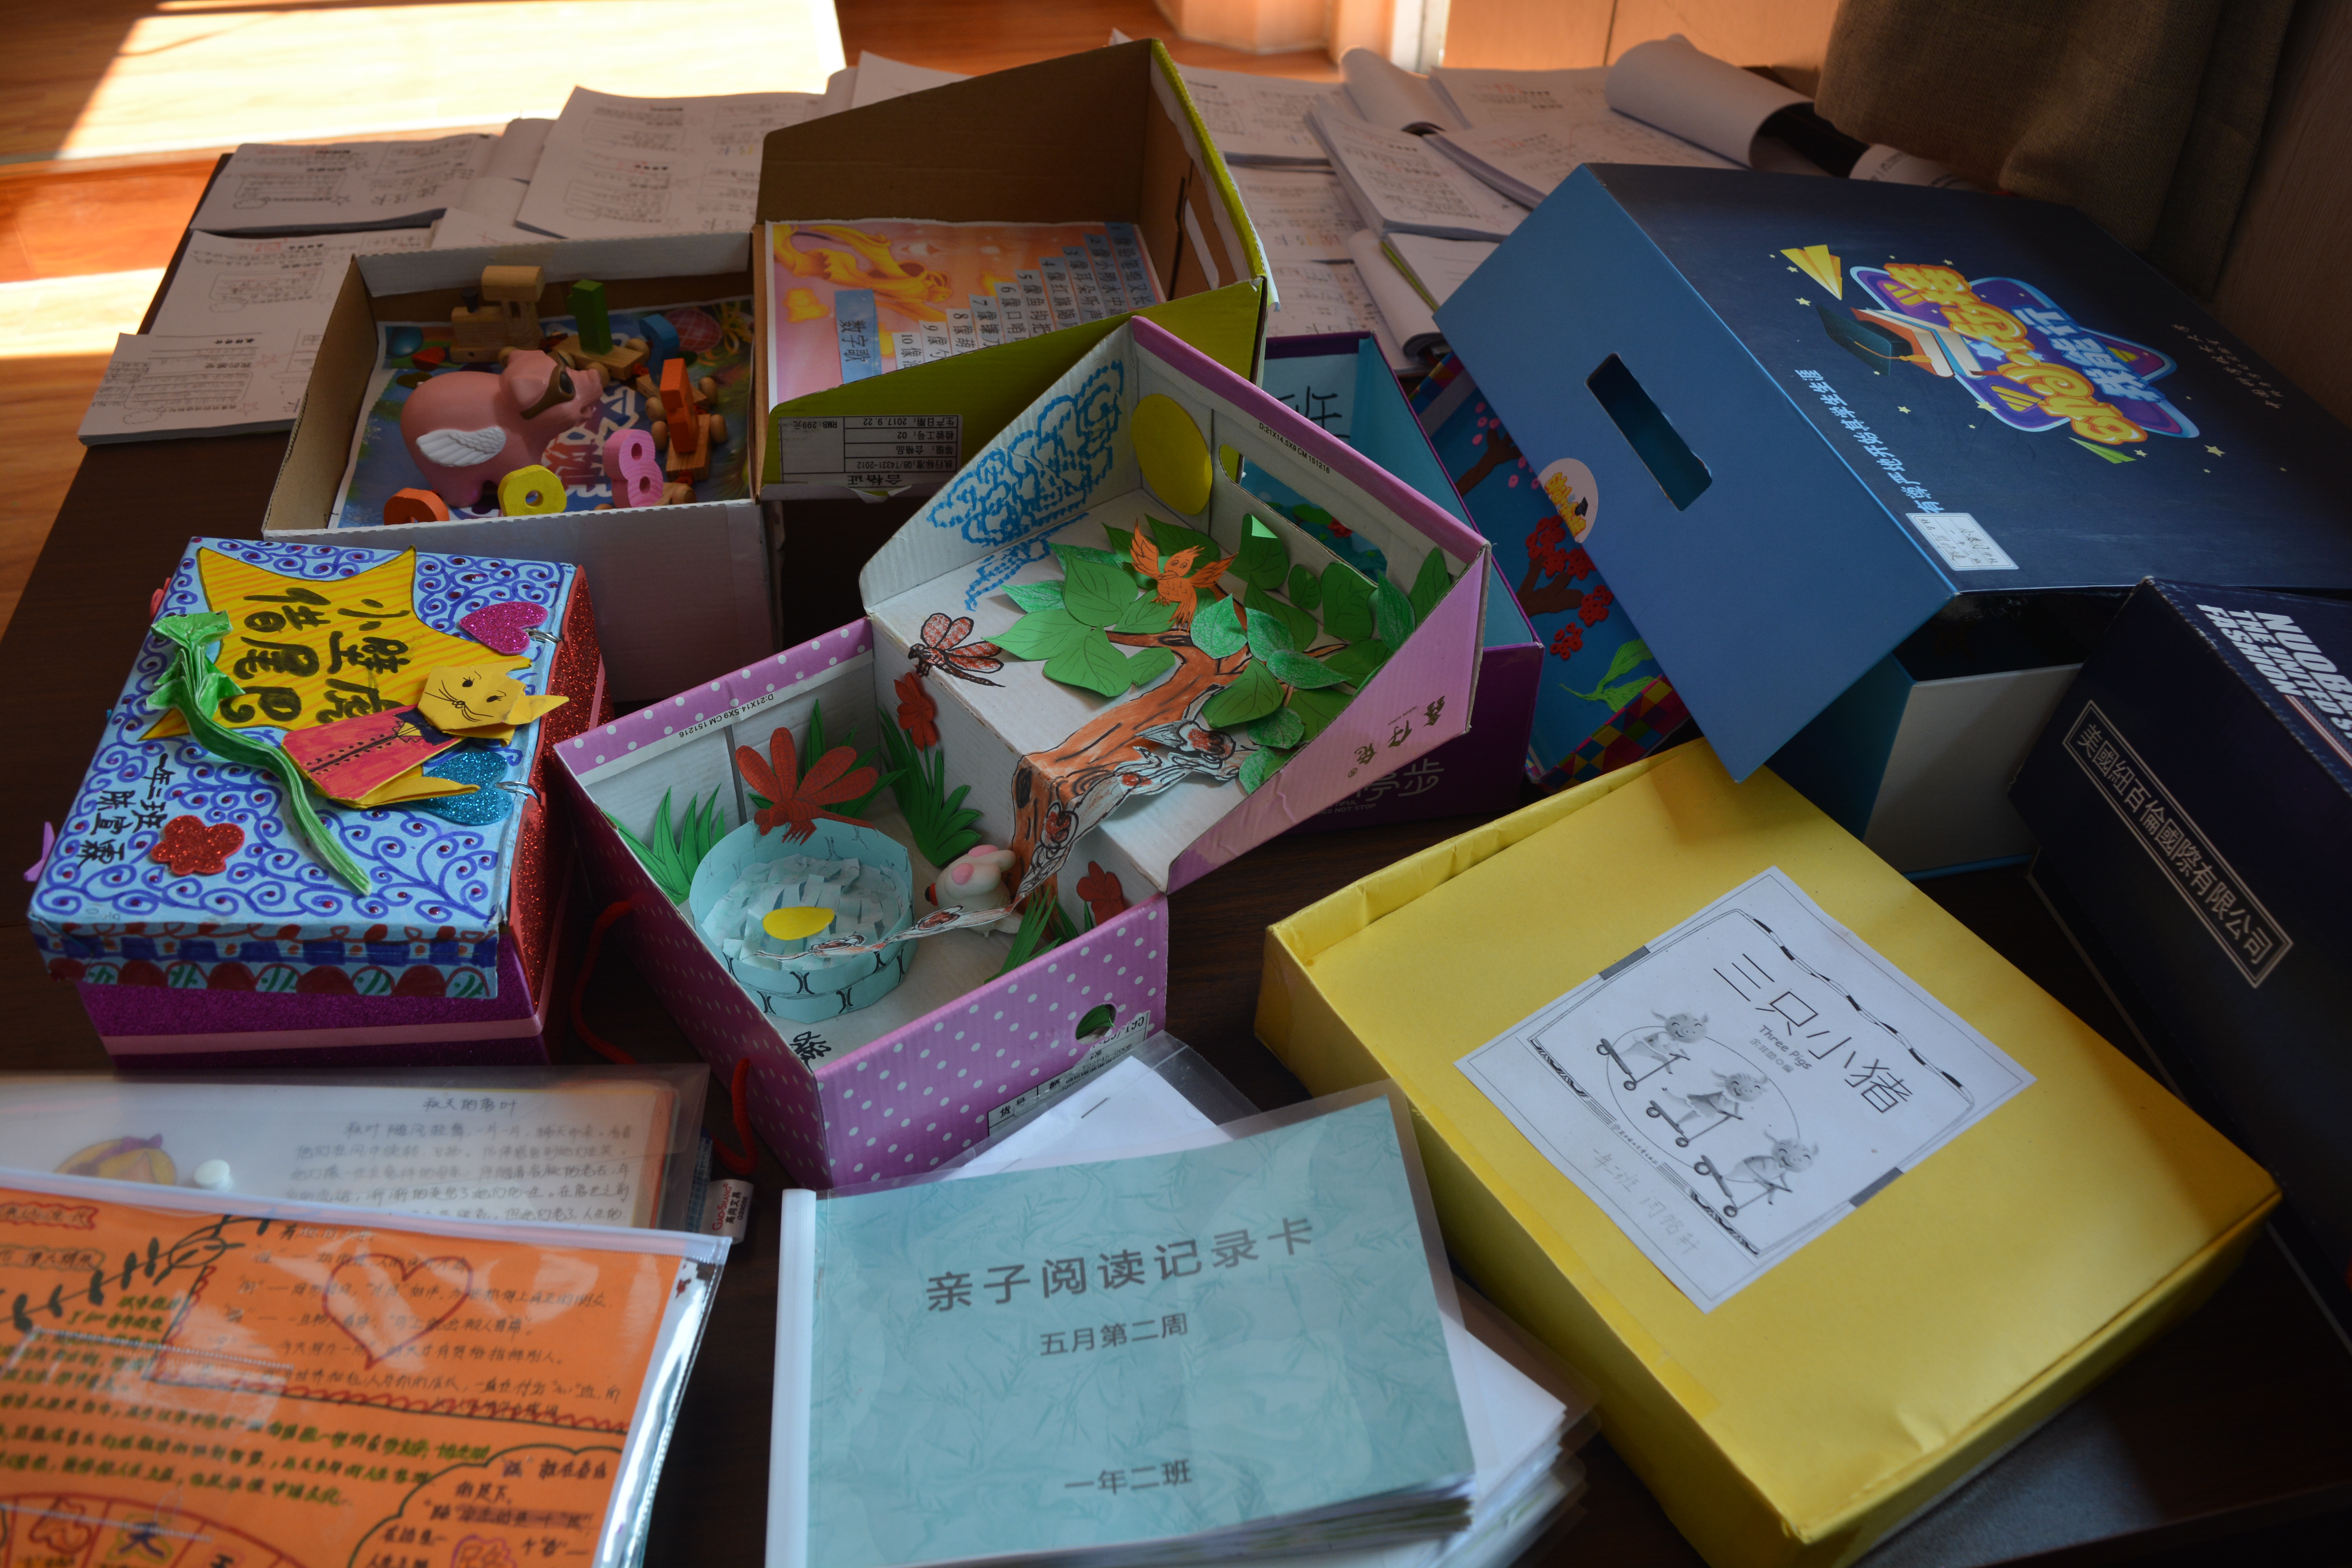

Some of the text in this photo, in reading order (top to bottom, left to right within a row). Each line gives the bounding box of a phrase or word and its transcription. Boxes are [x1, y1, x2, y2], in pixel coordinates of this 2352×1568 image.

[1000, 286, 1016, 294] 6
[839, 318, 871, 362] 数字歌
[902, 334, 913, 344] 10
[953, 325, 976, 354] 像葫
[2011, 304, 2165, 403] 我能行
[896, 445, 924, 455] 合格品
[897, 431, 907, 439] 02
[1259, 422, 1330, 474] D:21X14.5X9 CM 151216
[1795, 370, 1944, 513] 有尊严地开始其学生生涯
[848, 474, 902, 485] 合格证
[315, 598, 411, 724] 小壁虎
[2196, 604, 2306, 697] FASHION
[2228, 610, 2279, 644] THE
[2262, 646, 2345, 715] UNITED
[679, 693, 774, 738] D:21X14.5X9 CM 151216
[131, 753, 176, 833] 一年二班
[1713, 953, 1914, 1112] 三只小猪
[1760, 1024, 1813, 1071] Three Pigs
[726, 1191, 742, 1224] 高尚文具
[926, 1216, 1313, 1312] 亲子阅读记录卡
[1039, 1313, 1188, 1356] 五月第二周
[1064, 1459, 1193, 1495] 一年二班
